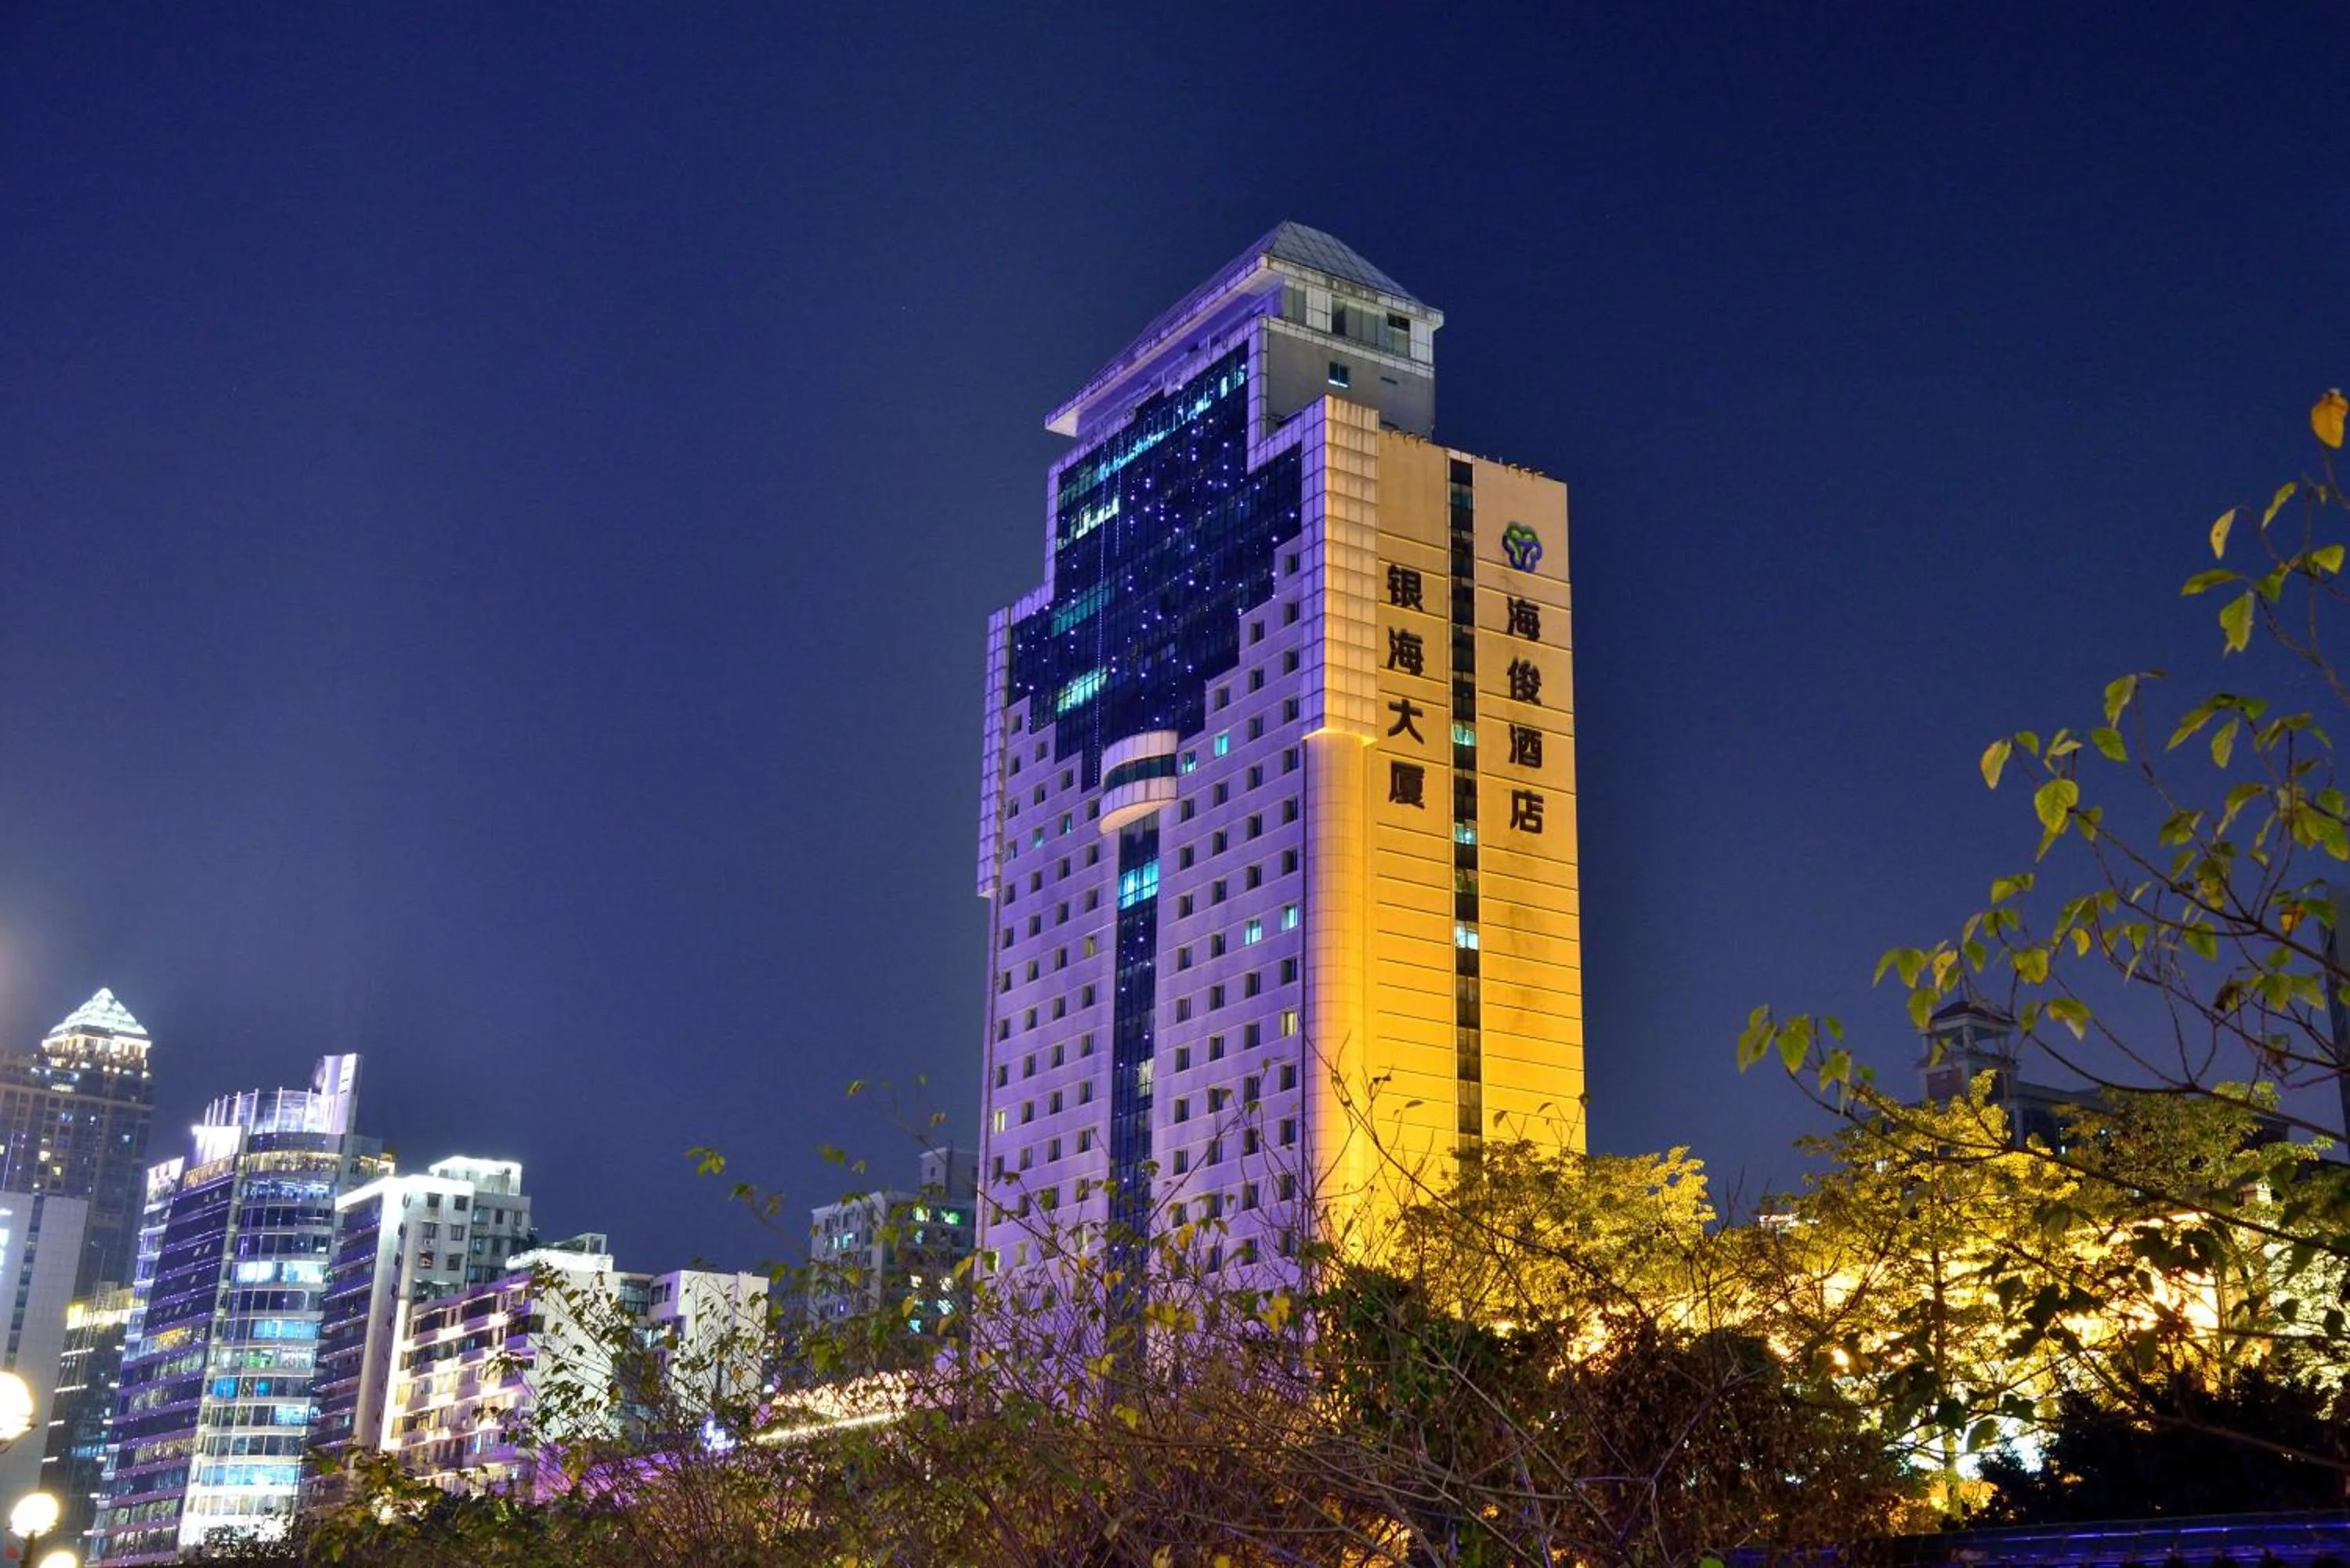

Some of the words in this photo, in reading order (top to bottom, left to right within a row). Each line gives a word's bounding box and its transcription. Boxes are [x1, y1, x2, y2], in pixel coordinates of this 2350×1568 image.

[1387, 564, 1424, 809] 银海大厦
[1507, 597, 1543, 834] 海俊酒店
